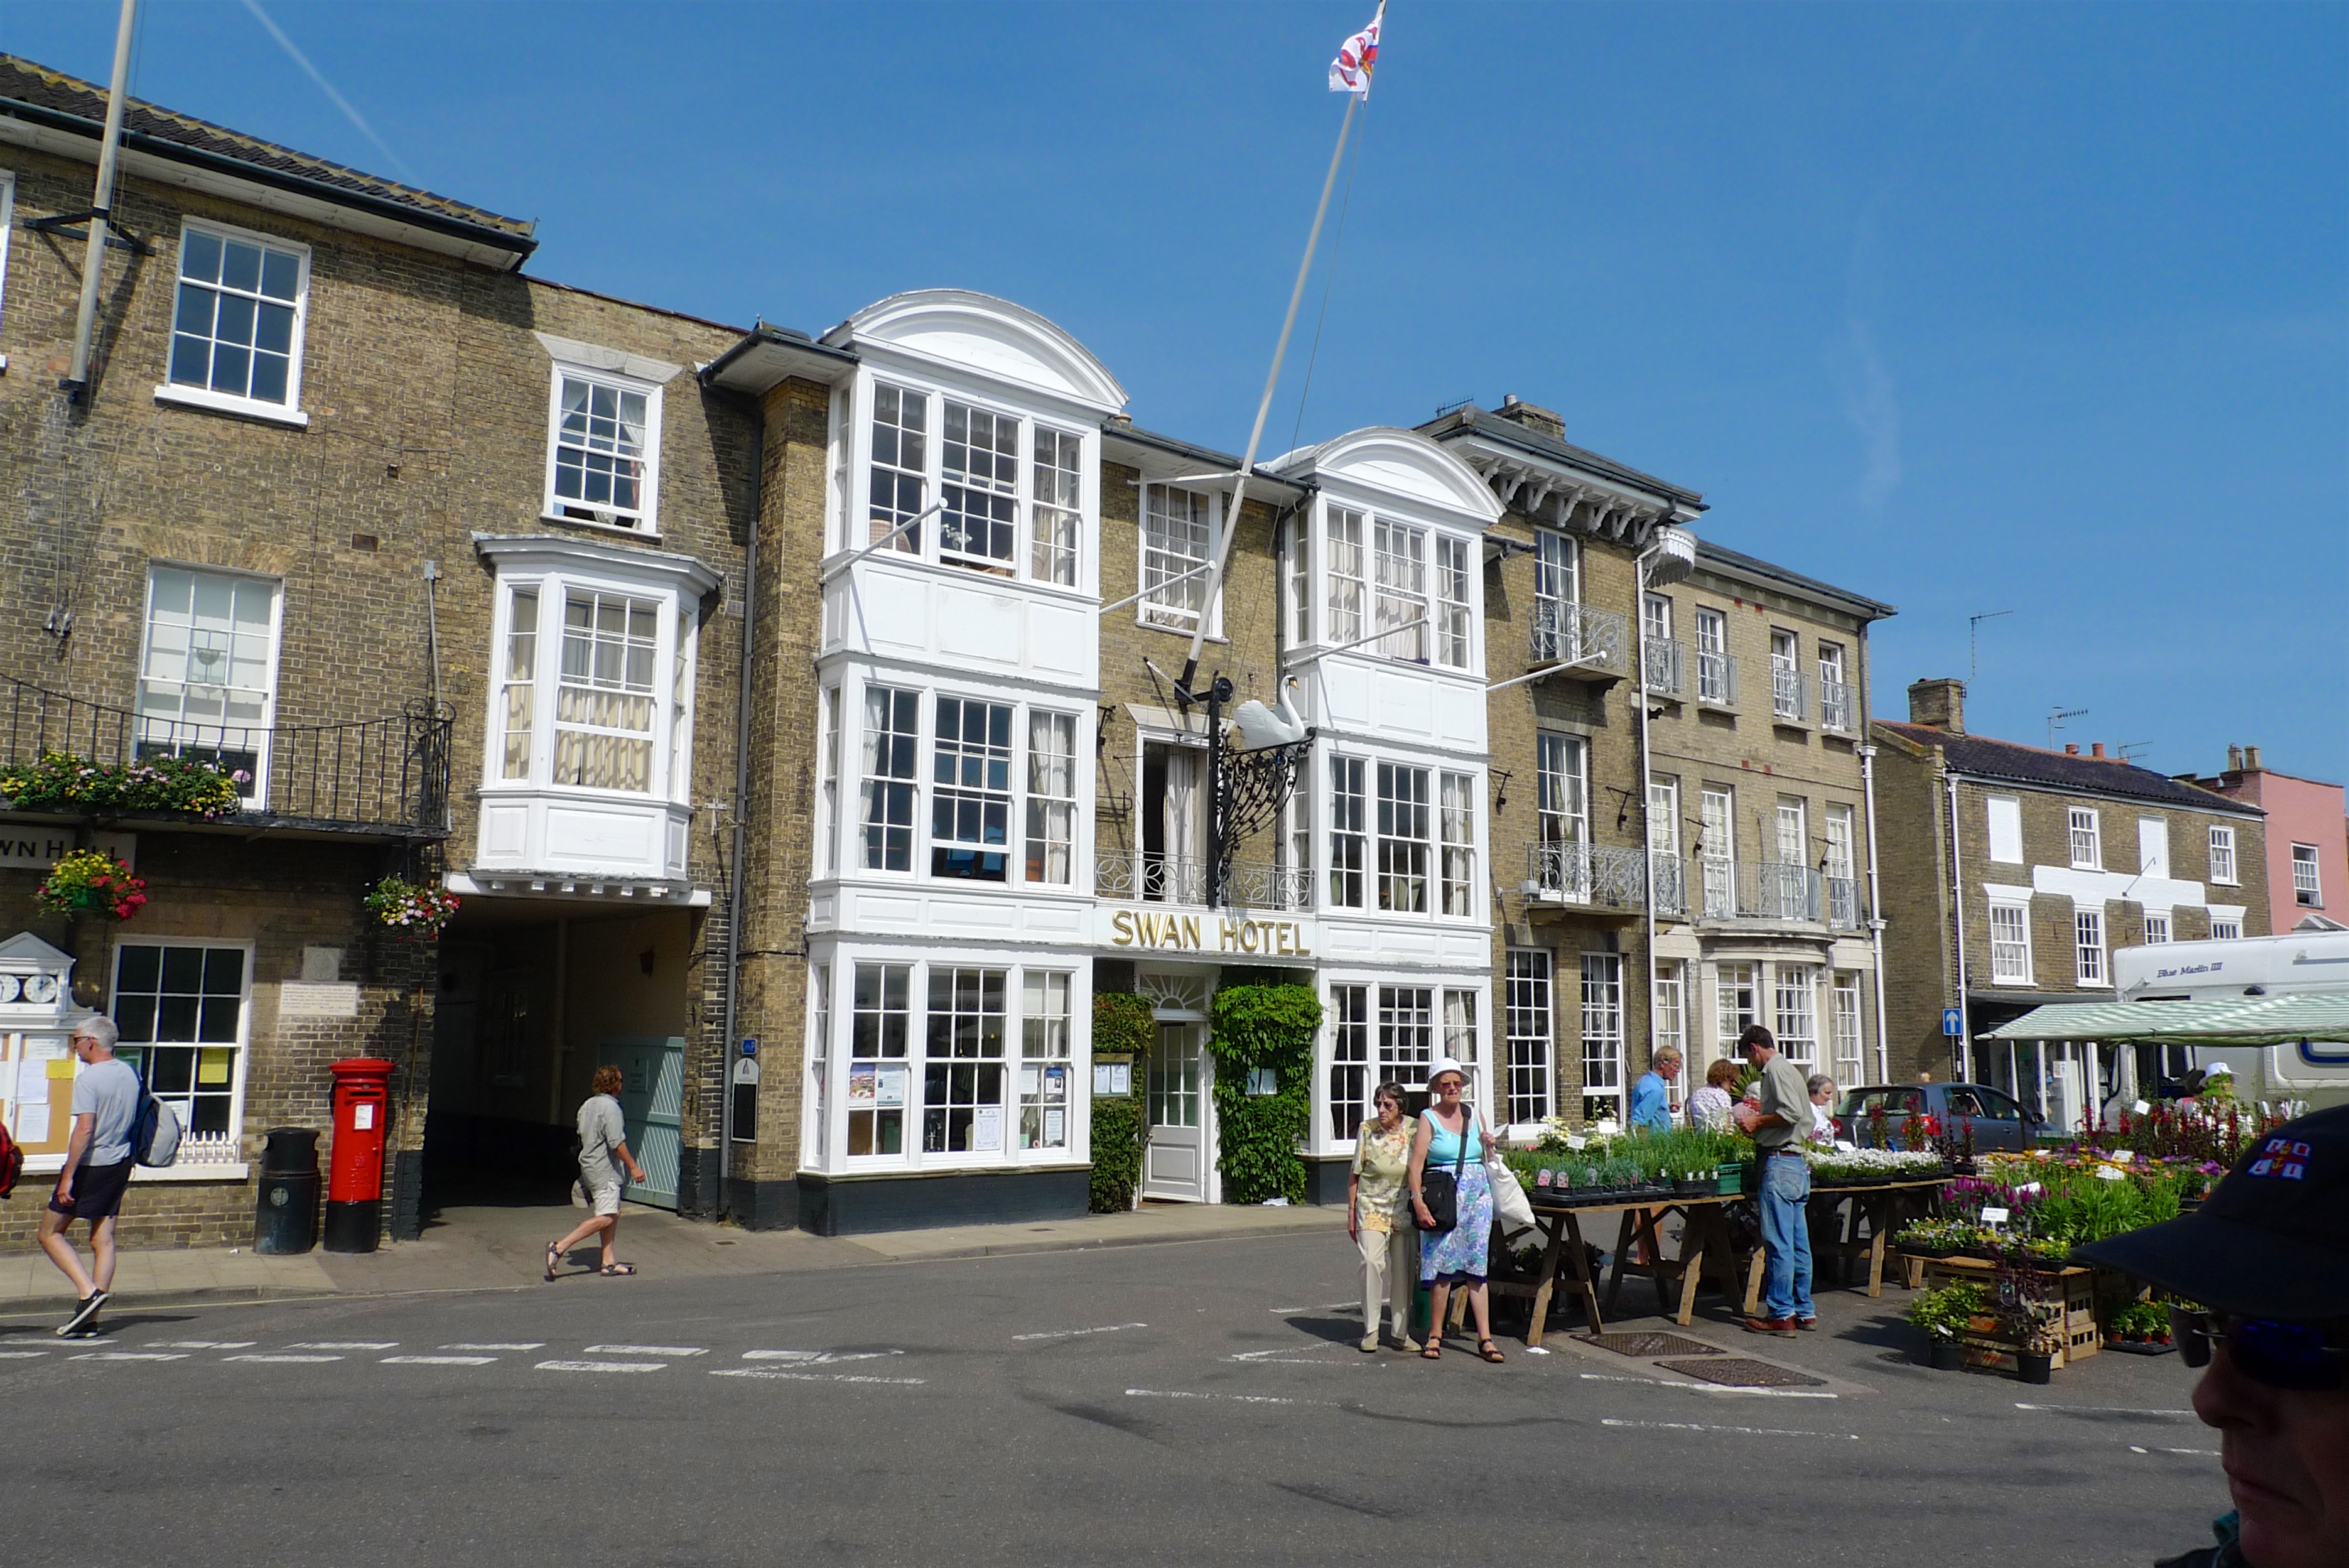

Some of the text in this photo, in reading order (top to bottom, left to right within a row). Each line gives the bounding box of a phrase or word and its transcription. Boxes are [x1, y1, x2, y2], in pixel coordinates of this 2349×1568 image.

[1111, 910, 1310, 954] SWAN HOTEL
[2157, 969, 2178, 978] Blue
[2180, 964, 2209, 975] Marlin
